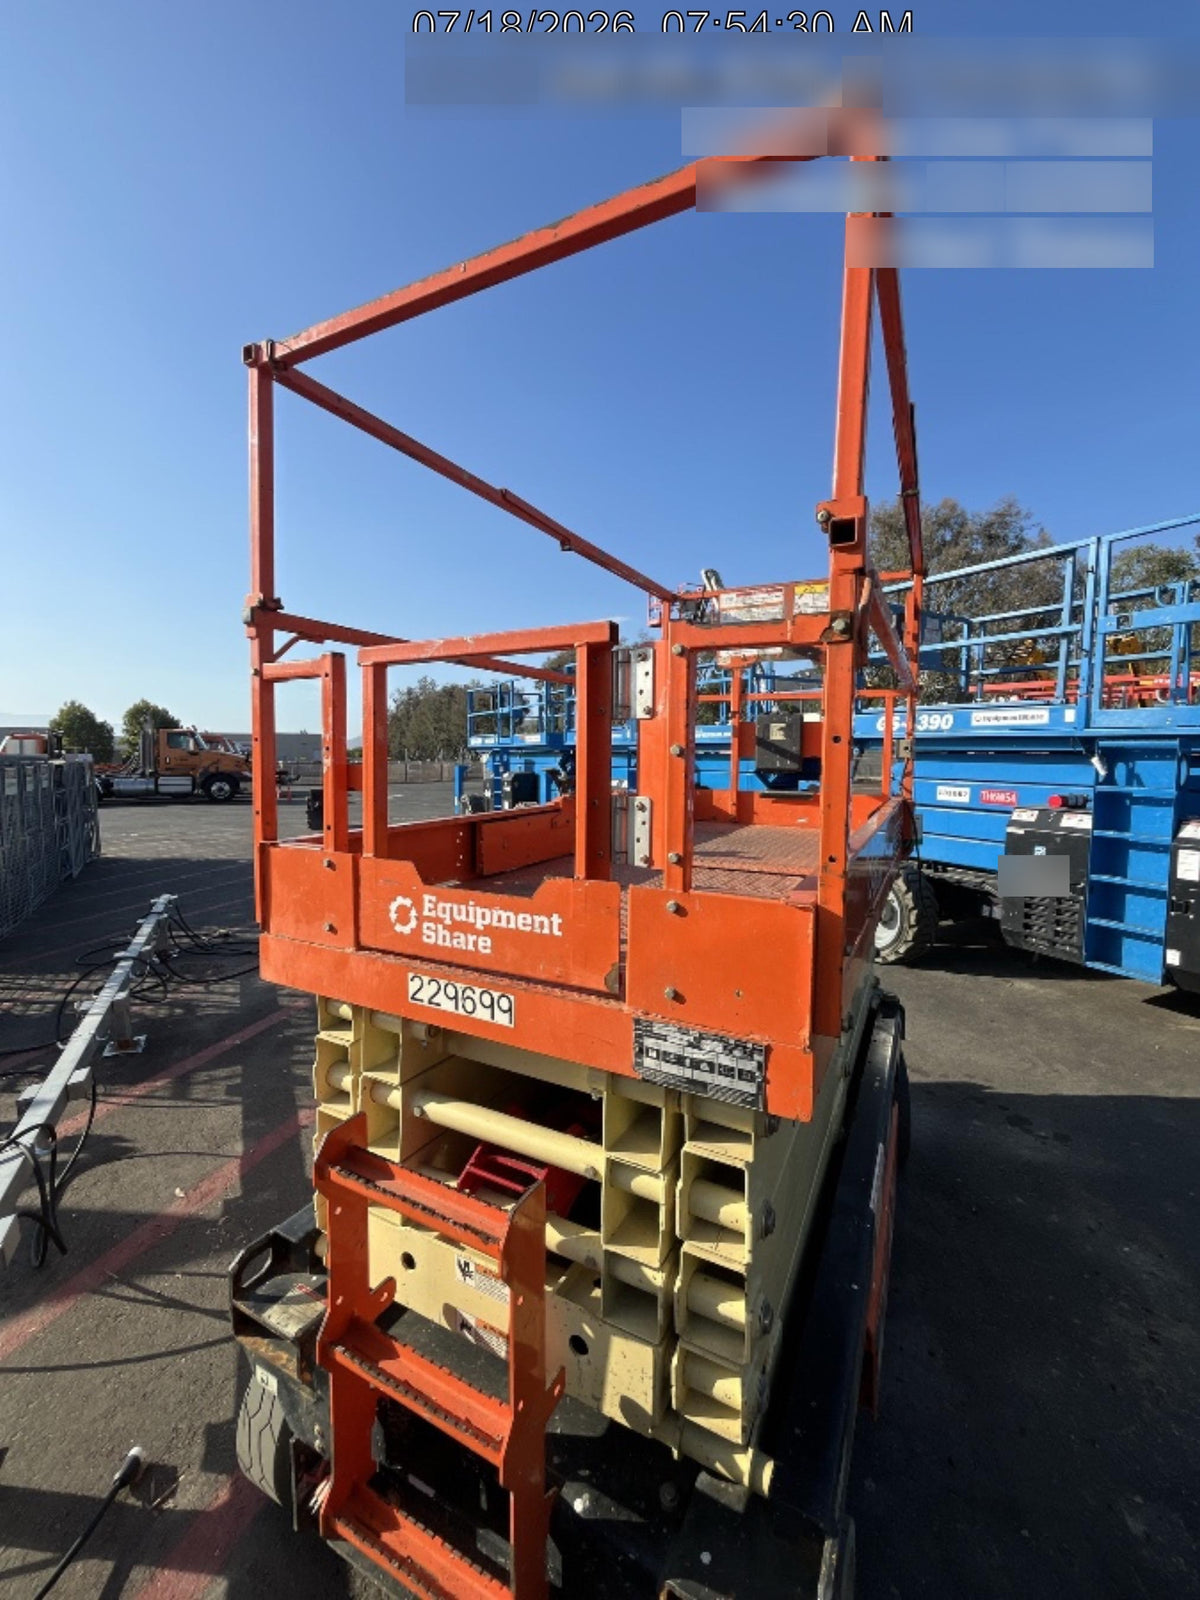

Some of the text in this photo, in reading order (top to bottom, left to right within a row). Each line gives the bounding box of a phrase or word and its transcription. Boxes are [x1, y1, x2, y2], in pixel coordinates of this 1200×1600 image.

[422, 894, 563, 937] Equipment
[422, 921, 493, 955] Share
[409, 974, 514, 1026] 229699
